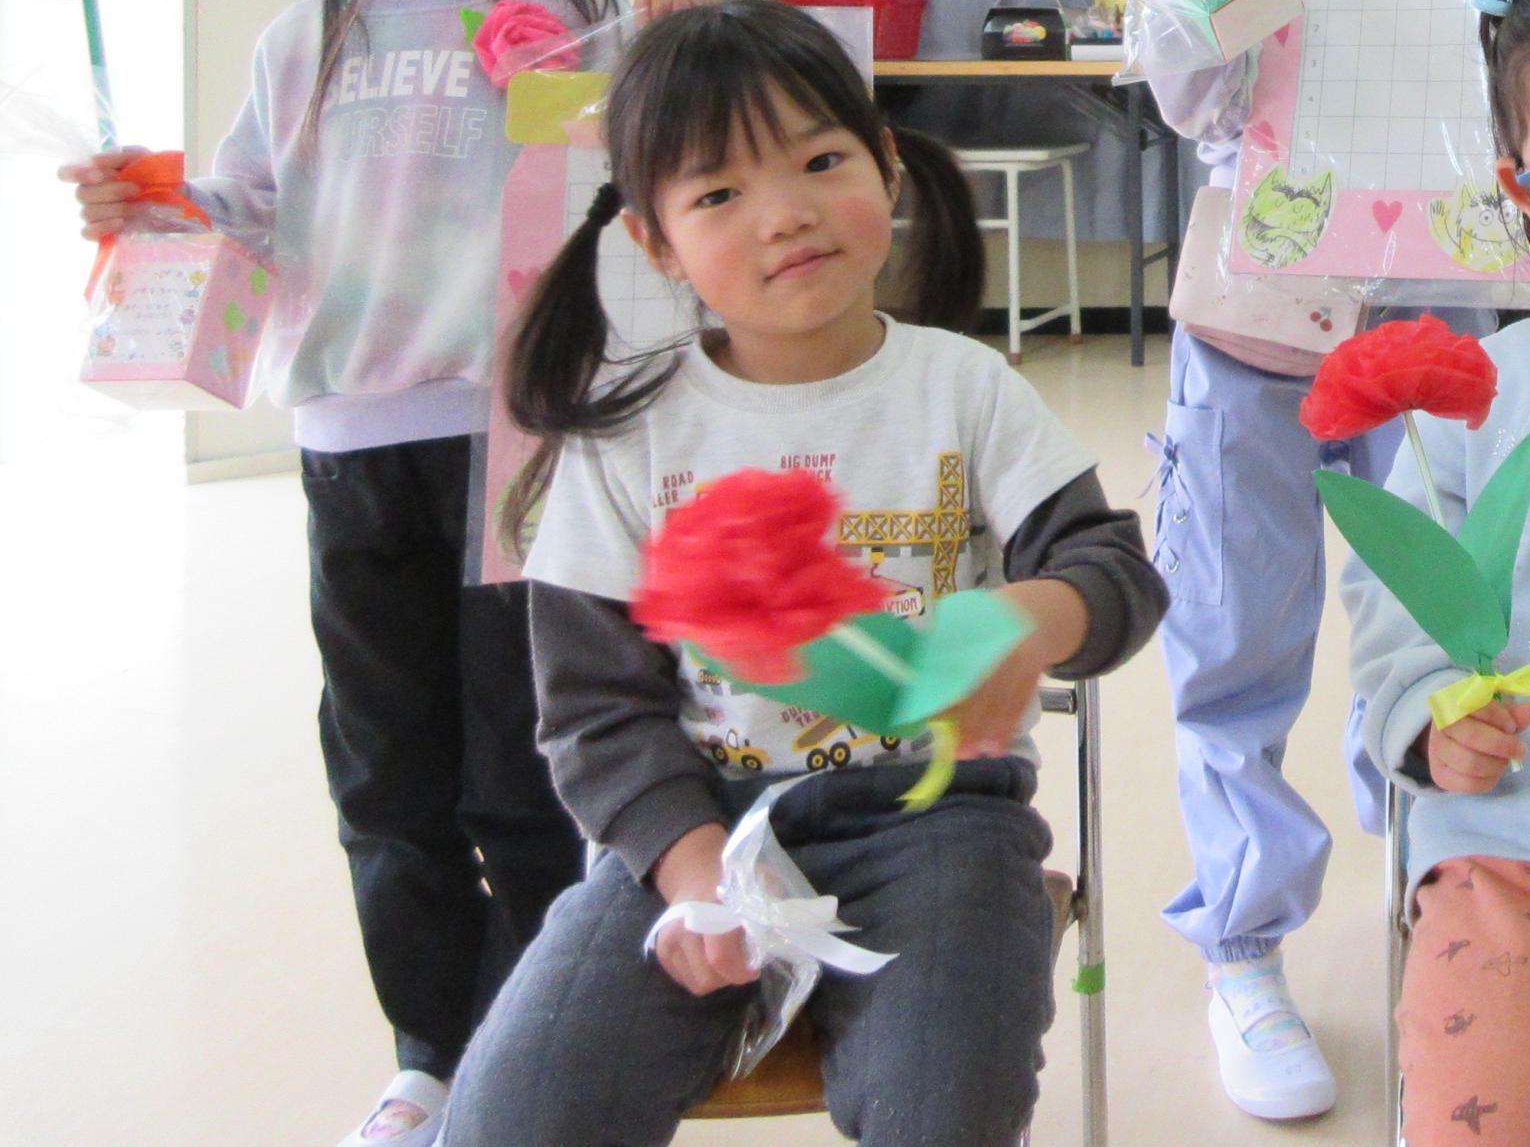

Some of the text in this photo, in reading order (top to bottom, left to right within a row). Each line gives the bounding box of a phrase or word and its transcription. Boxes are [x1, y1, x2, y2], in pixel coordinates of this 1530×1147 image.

[339, 49, 475, 105] ELIEVE
[780, 452, 836, 469] BIG DUMP
[662, 470, 694, 490] ROAD
